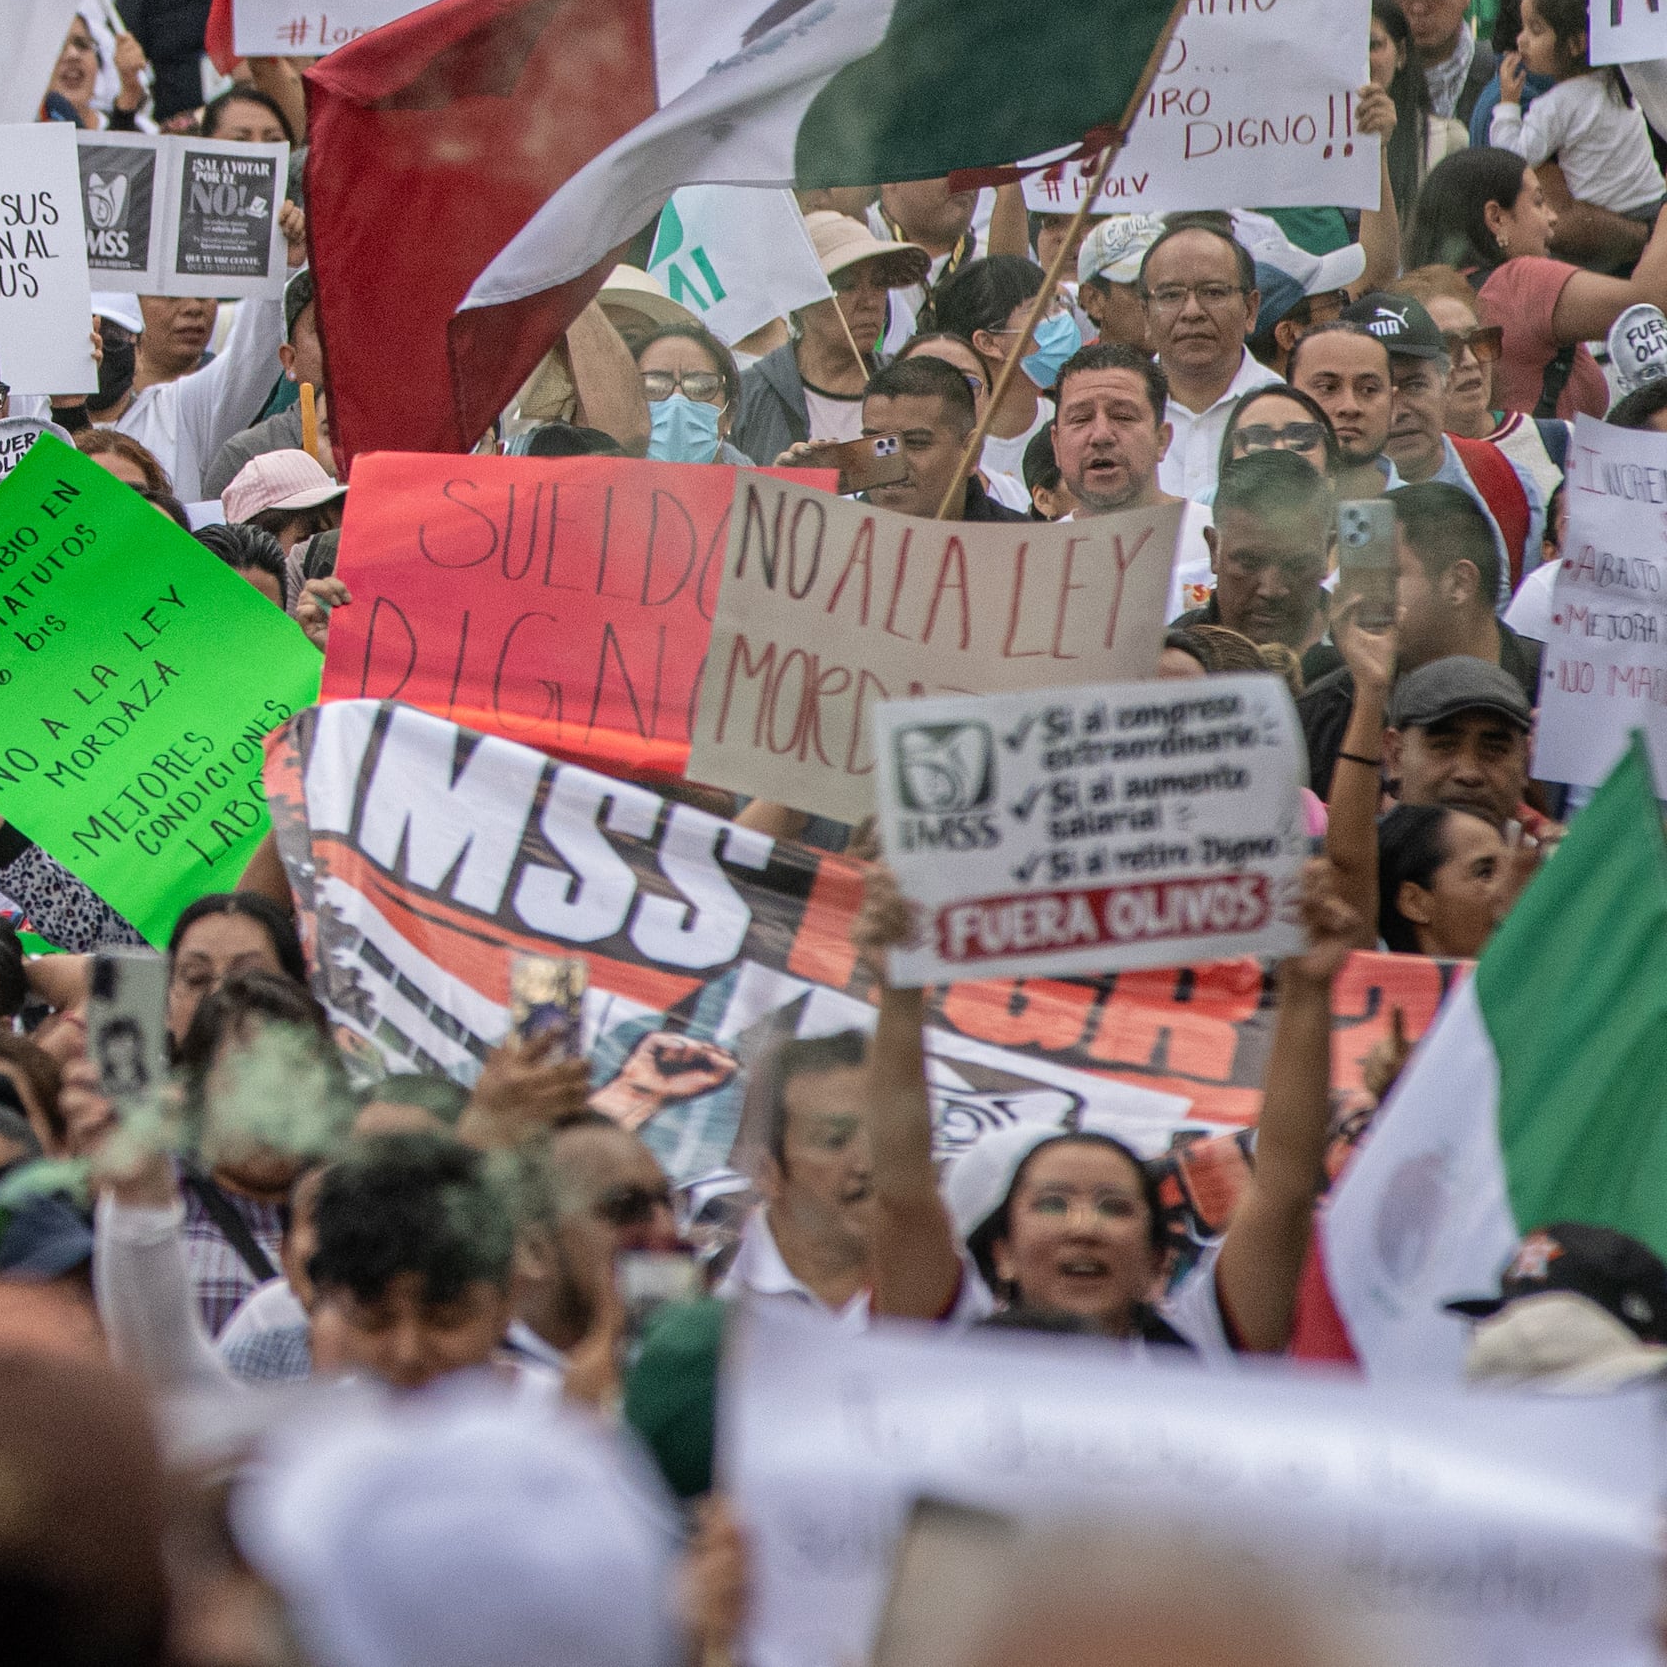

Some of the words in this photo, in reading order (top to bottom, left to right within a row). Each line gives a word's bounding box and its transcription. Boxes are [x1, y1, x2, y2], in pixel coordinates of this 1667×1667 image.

[1148, 88, 1211, 119] IRO
[188, 182, 248, 217] NO!
[195, 171, 220, 184] POR
[230, 161, 271, 177] VOTAR
[1035, 172, 1150, 203] #HOLV
[0, 191, 60, 226] SUS
[23, 229, 60, 260] AL
[86, 228, 130, 259] MSS
[41, 478, 83, 521] EN
[735, 483, 827, 600] NO
[826, 516, 876, 627] A
[885, 527, 971, 651] LA
[1003, 526, 1155, 660] LEY
[41, 716, 70, 743] A
[72, 662, 119, 706] LA
[123, 583, 189, 654] LEY
[361, 596, 708, 745] DIGN
[43, 658, 182, 789] MORDAZA
[71, 729, 216, 859] MEJORES
[135, 699, 292, 857] CONDICIONES
[187, 770, 266, 868] LABO
[305, 699, 775, 970] IMSS
[946, 891, 1100, 958] FUERA
[1103, 877, 1267, 936] OLIVOS
